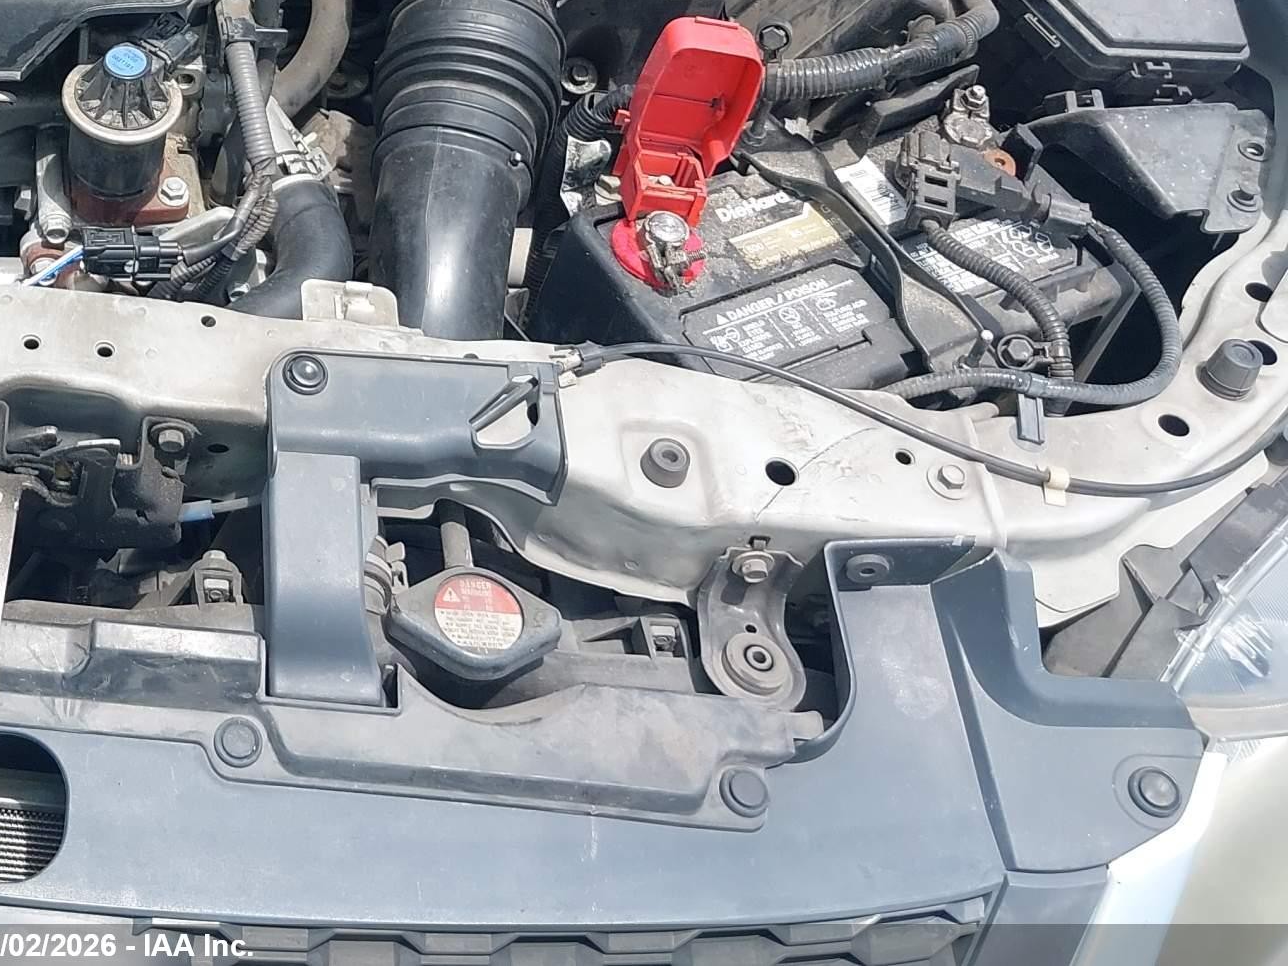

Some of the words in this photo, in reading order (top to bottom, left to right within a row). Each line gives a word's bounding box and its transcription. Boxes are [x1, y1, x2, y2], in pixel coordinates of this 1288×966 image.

[715, 190, 791, 223] DieHard
[726, 296, 779, 322] DANGER
[784, 278, 829, 300] POISON
